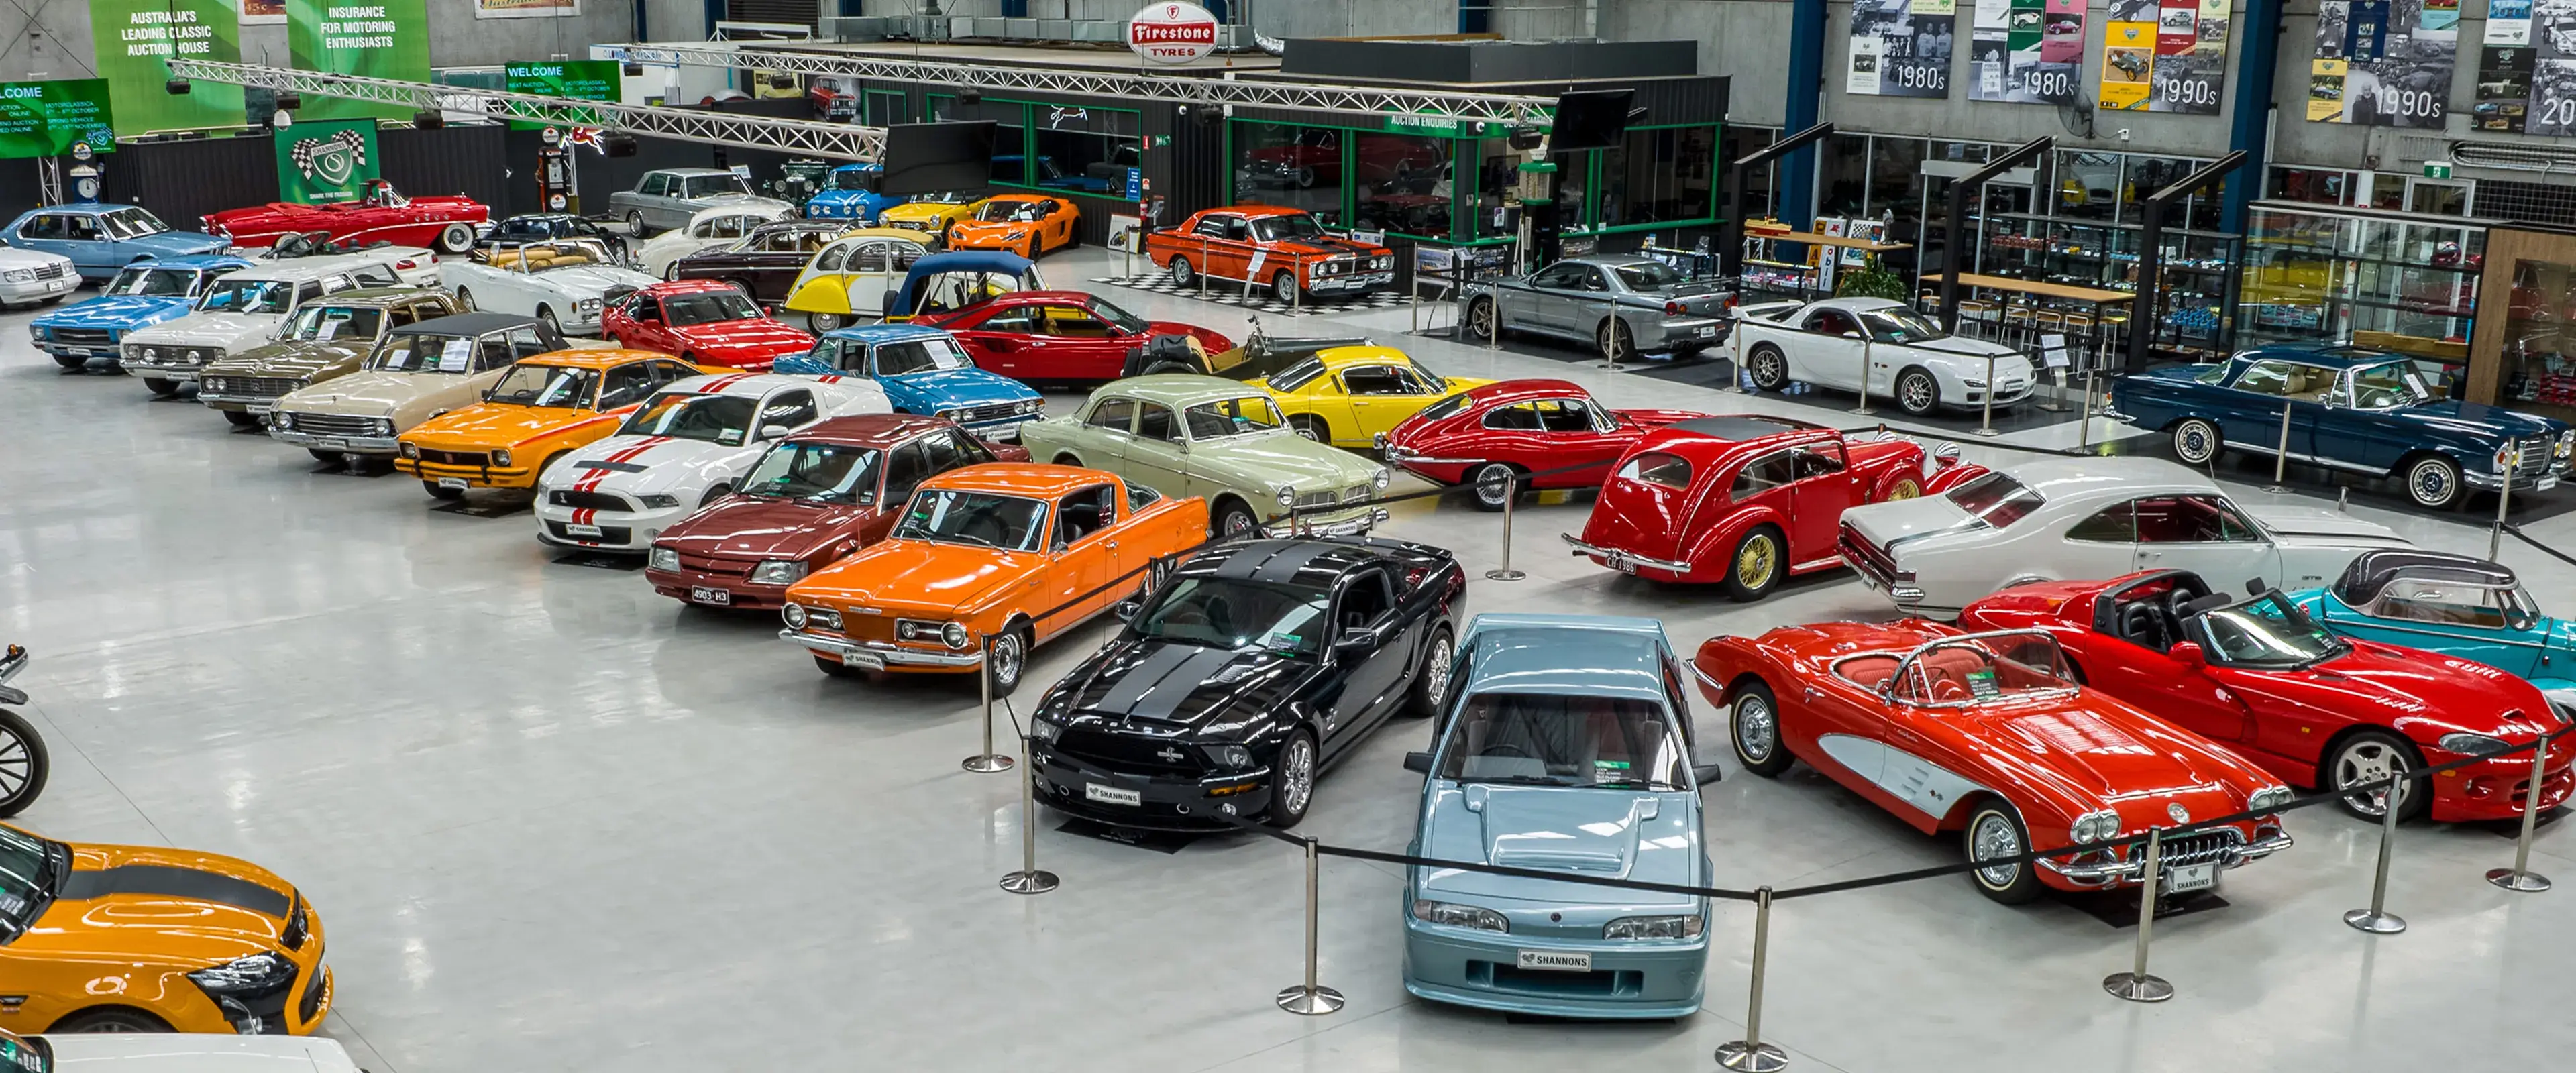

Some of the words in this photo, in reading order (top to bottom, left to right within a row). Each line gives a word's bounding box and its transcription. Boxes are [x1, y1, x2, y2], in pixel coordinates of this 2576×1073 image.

[131, 11, 197, 24] AUSTRALIA'S
[329, 6, 386, 18] INSURANCE
[121, 27, 166, 40] LEADING
[169, 25, 211, 39] CLASSIC
[321, 23, 341, 34] FOR
[343, 21, 396, 33] MOTORING
[1134, 25, 1211, 42] Firestone
[325, 36, 394, 48] ENTHUSIASTS
[127, 43, 172, 56] AUCTION
[1151, 48, 1195, 56] TYRES
[508, 67, 563, 76] WELCOME
[1898, 66, 1944, 89] 1980s
[2023, 72, 2074, 96] 1980s
[0, 87, 42, 99] LCOME
[2161, 78, 2216, 105] 1990s
[2377, 89, 2441, 117] 1990s
[1391, 115, 1420, 126] AUCTION
[1421, 117, 1458, 129] ENQUIRIES
[313, 142, 347, 155] SHANNONS
[855, 656, 881, 665] SHANNONS
[1099, 790, 1138, 803] SHANNONS
[2177, 879, 2209, 891] SHANNONS
[1536, 955, 1588, 967] SHANNONS
